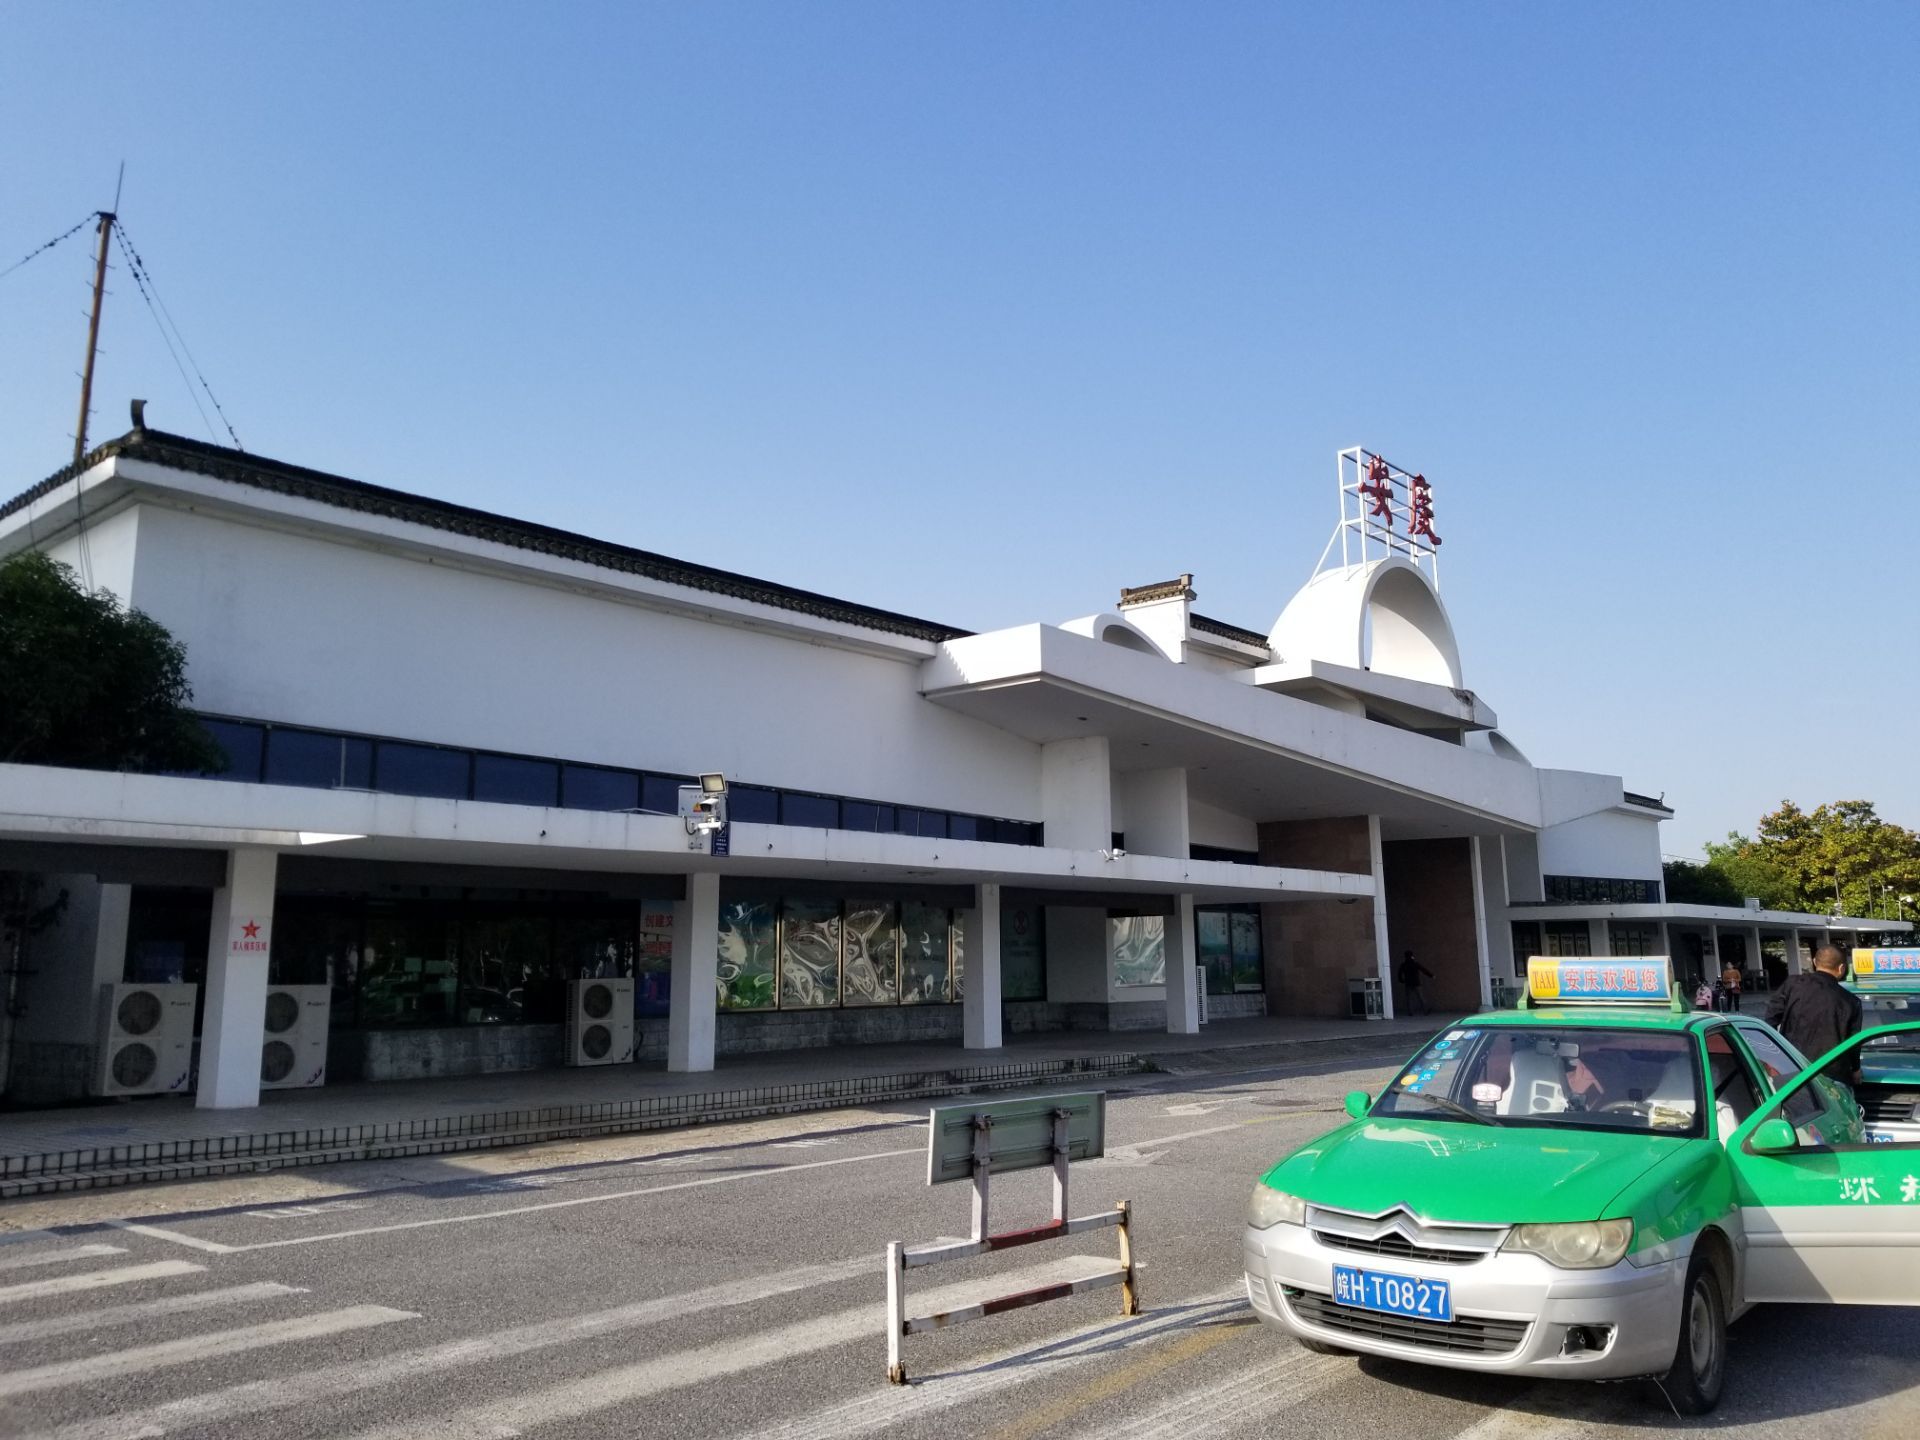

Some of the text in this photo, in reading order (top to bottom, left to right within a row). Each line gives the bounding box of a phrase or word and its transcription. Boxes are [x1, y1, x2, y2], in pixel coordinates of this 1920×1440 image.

[1532, 969, 1556, 990] TAXI
[1564, 967, 1659, 992] 安庆欢迎您
